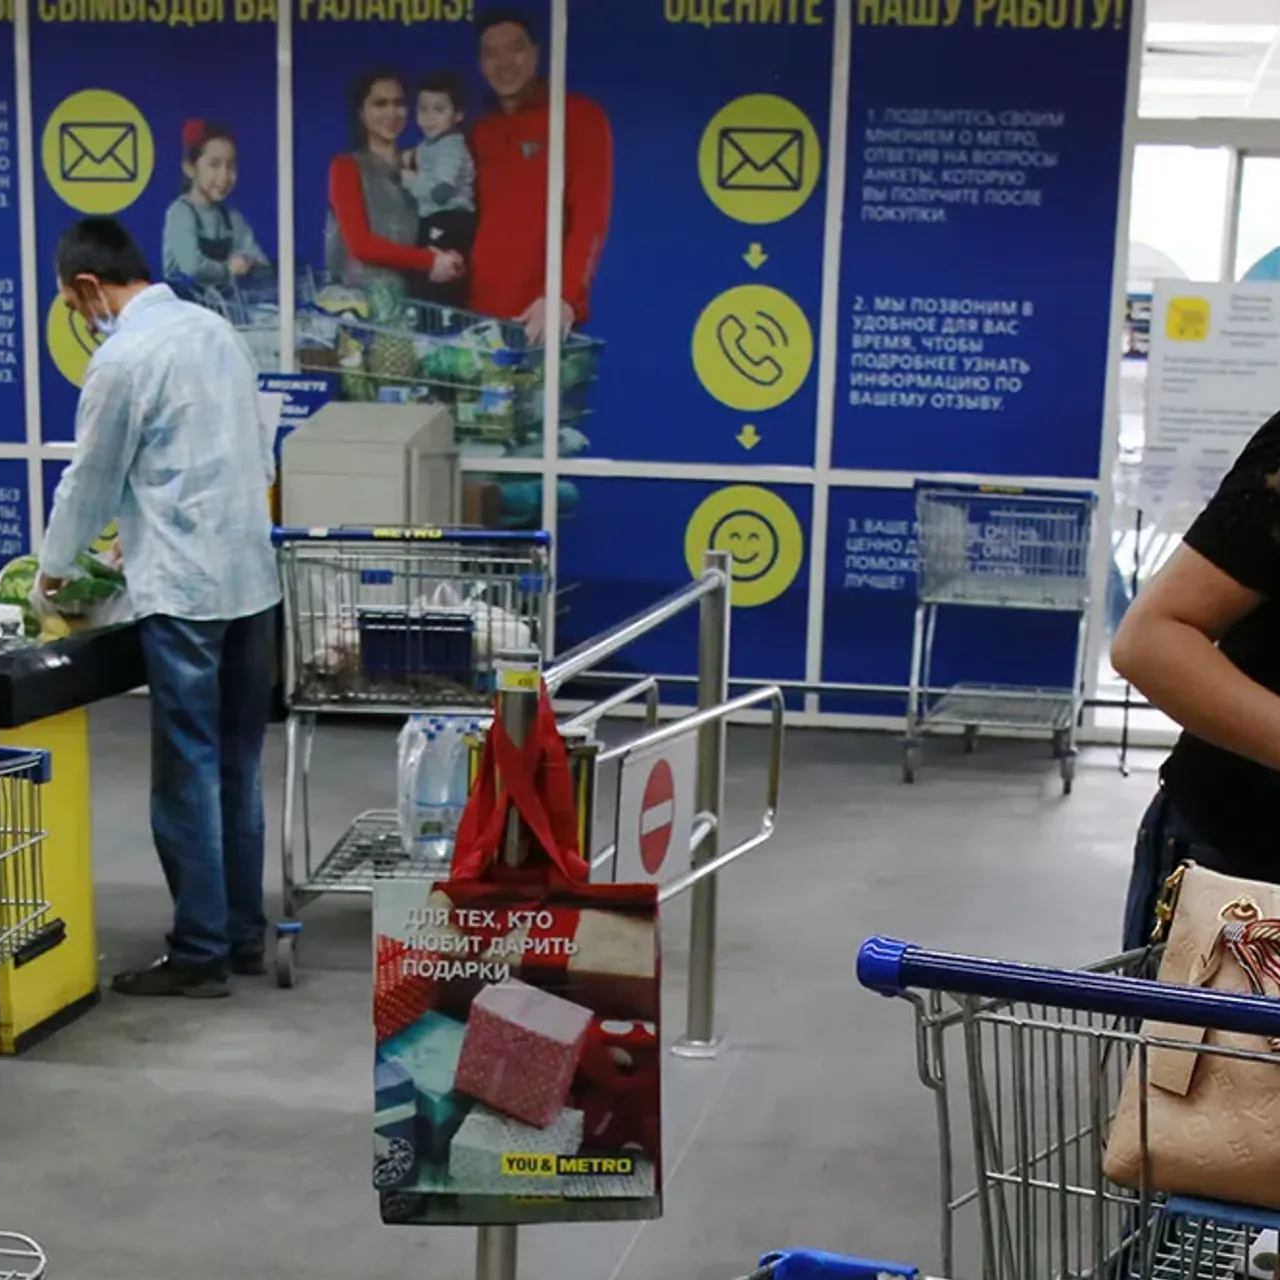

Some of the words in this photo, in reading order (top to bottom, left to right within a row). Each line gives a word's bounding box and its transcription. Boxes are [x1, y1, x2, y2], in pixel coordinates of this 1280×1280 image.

[858, 0, 959, 26] НАШУ
[973, 0, 1122, 28] РАБОТУ!
[874, 297, 906, 312] МЫ
[910, 297, 1018, 315] ПОЗВОНИМ
[1022, 301, 1034, 316] В
[852, 316, 937, 332] УДОБНОЕ
[941, 318, 978, 334] ДЛЯ
[982, 320, 1019, 336] ВАС
[921, 336, 983, 352] ЧТОБЫ
[851, 353, 957, 370] ПОДРОБНЕЕ
[962, 357, 1031, 374] УЗНАТЬ
[850, 372, 990, 391] ИНФОРМАЦИЮ
[994, 376, 1023, 392] ПО
[849, 391, 928, 407] ВАШЕМУ
[404, 909, 449, 931] ДЛЯ
[455, 909, 502, 930] ТЕХ,
[507, 910, 553, 930] КТО
[402, 935, 483, 953] ЛЮБИТ
[487, 936, 579, 957] ДАРИТЬ
[401, 959, 511, 981] ПОДАРКИ
[506, 1156, 539, 1172] YOU
[541, 1156, 553, 1171] &
[558, 1156, 633, 1174] METRO
